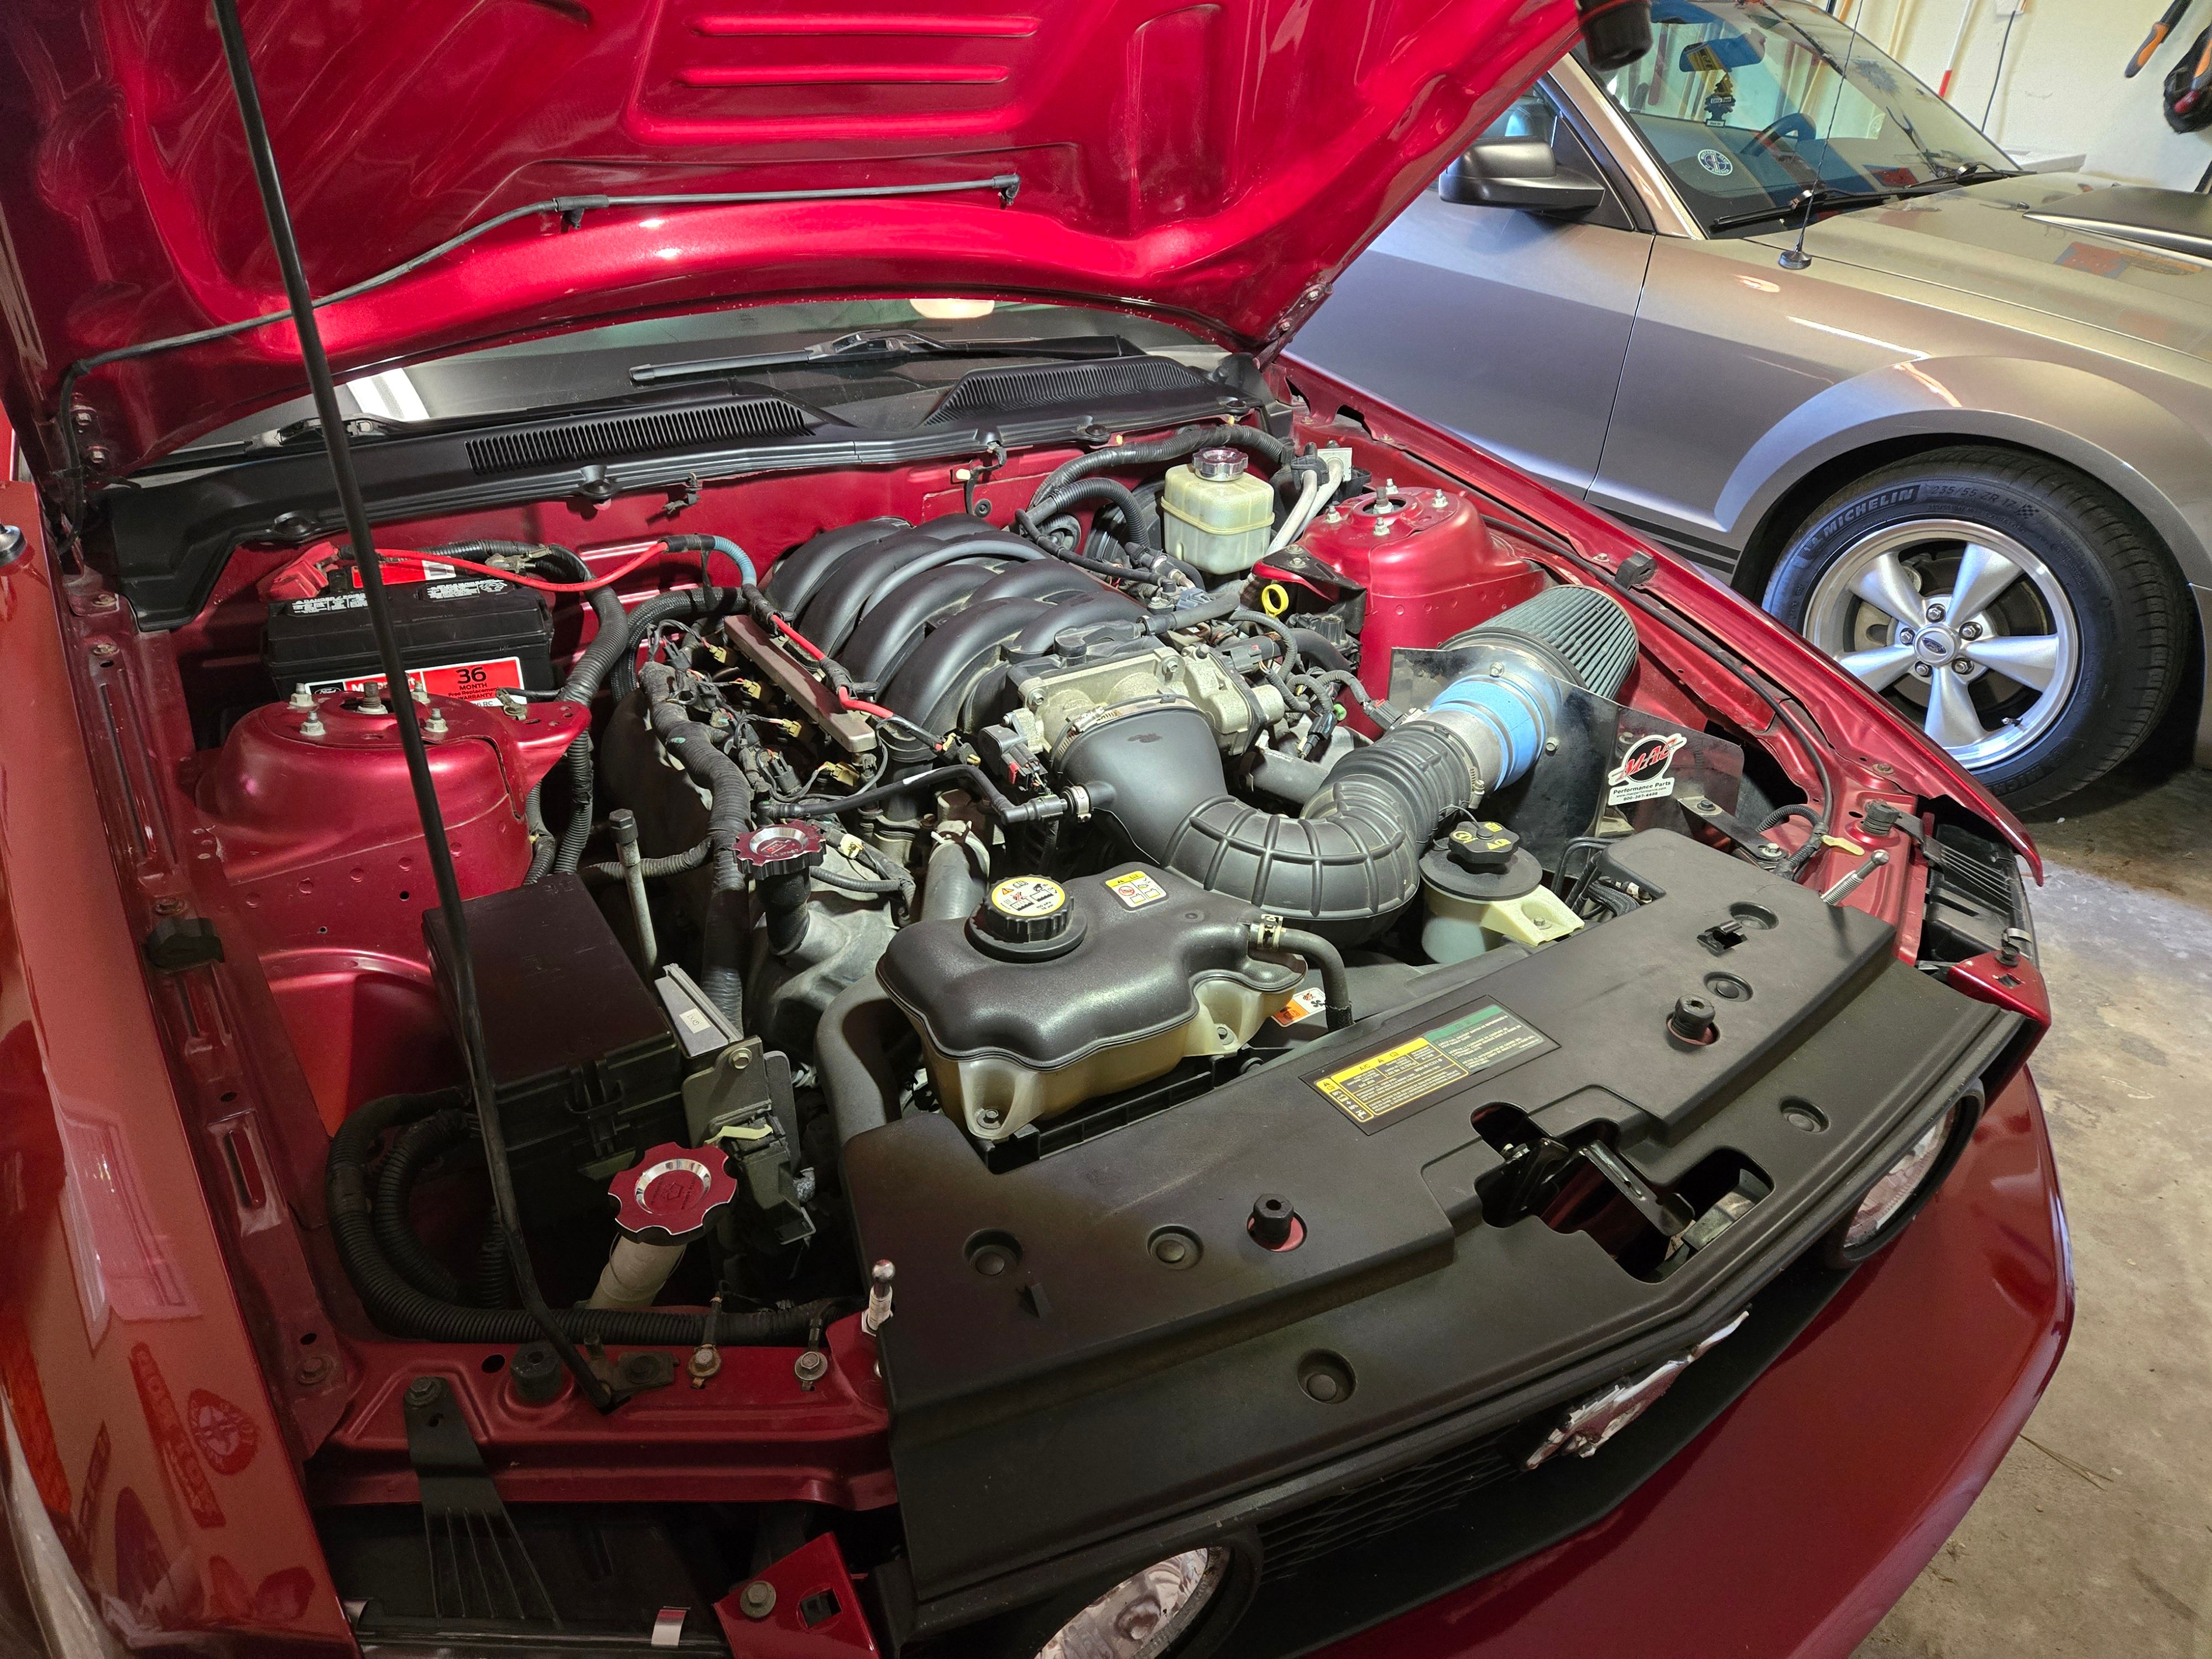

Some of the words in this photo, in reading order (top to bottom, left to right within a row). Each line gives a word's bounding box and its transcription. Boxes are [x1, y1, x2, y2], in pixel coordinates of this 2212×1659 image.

[1931, 486, 1978, 497] 235/55
[1981, 492, 2000, 502] ZR
[2001, 498, 2017, 508] 17
[1823, 488, 1914, 538] MICHELIN
[456, 666, 487, 684] 36
[462, 687, 498, 695] Replacemen
[1615, 737, 1677, 782] MAC
[1613, 783, 1653, 795] Performance
